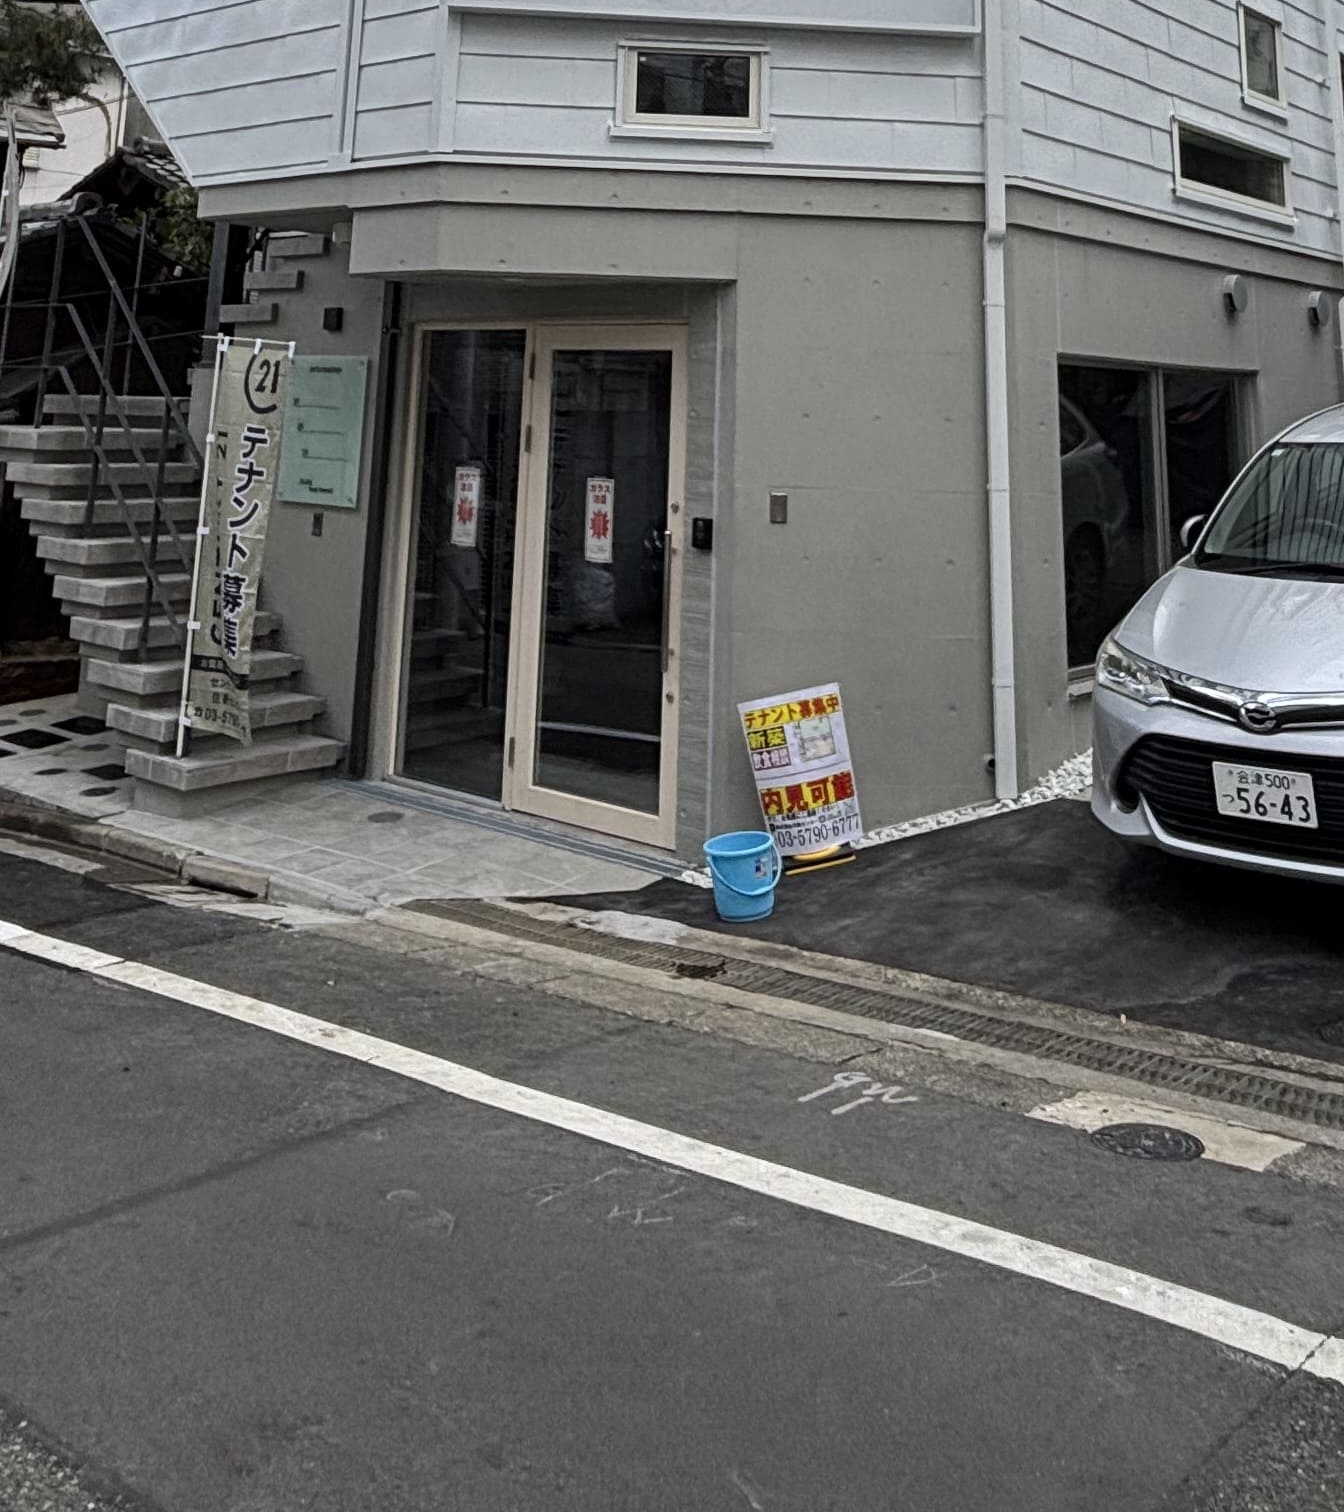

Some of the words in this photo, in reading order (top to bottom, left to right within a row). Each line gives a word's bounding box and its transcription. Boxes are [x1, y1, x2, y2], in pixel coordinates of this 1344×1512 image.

[744, 694, 840, 728] テナント募集中
[760, 771, 855, 816] 内見可能
[1236, 786, 1311, 823] 56-43
[777, 813, 860, 848] 03-5790-6777
